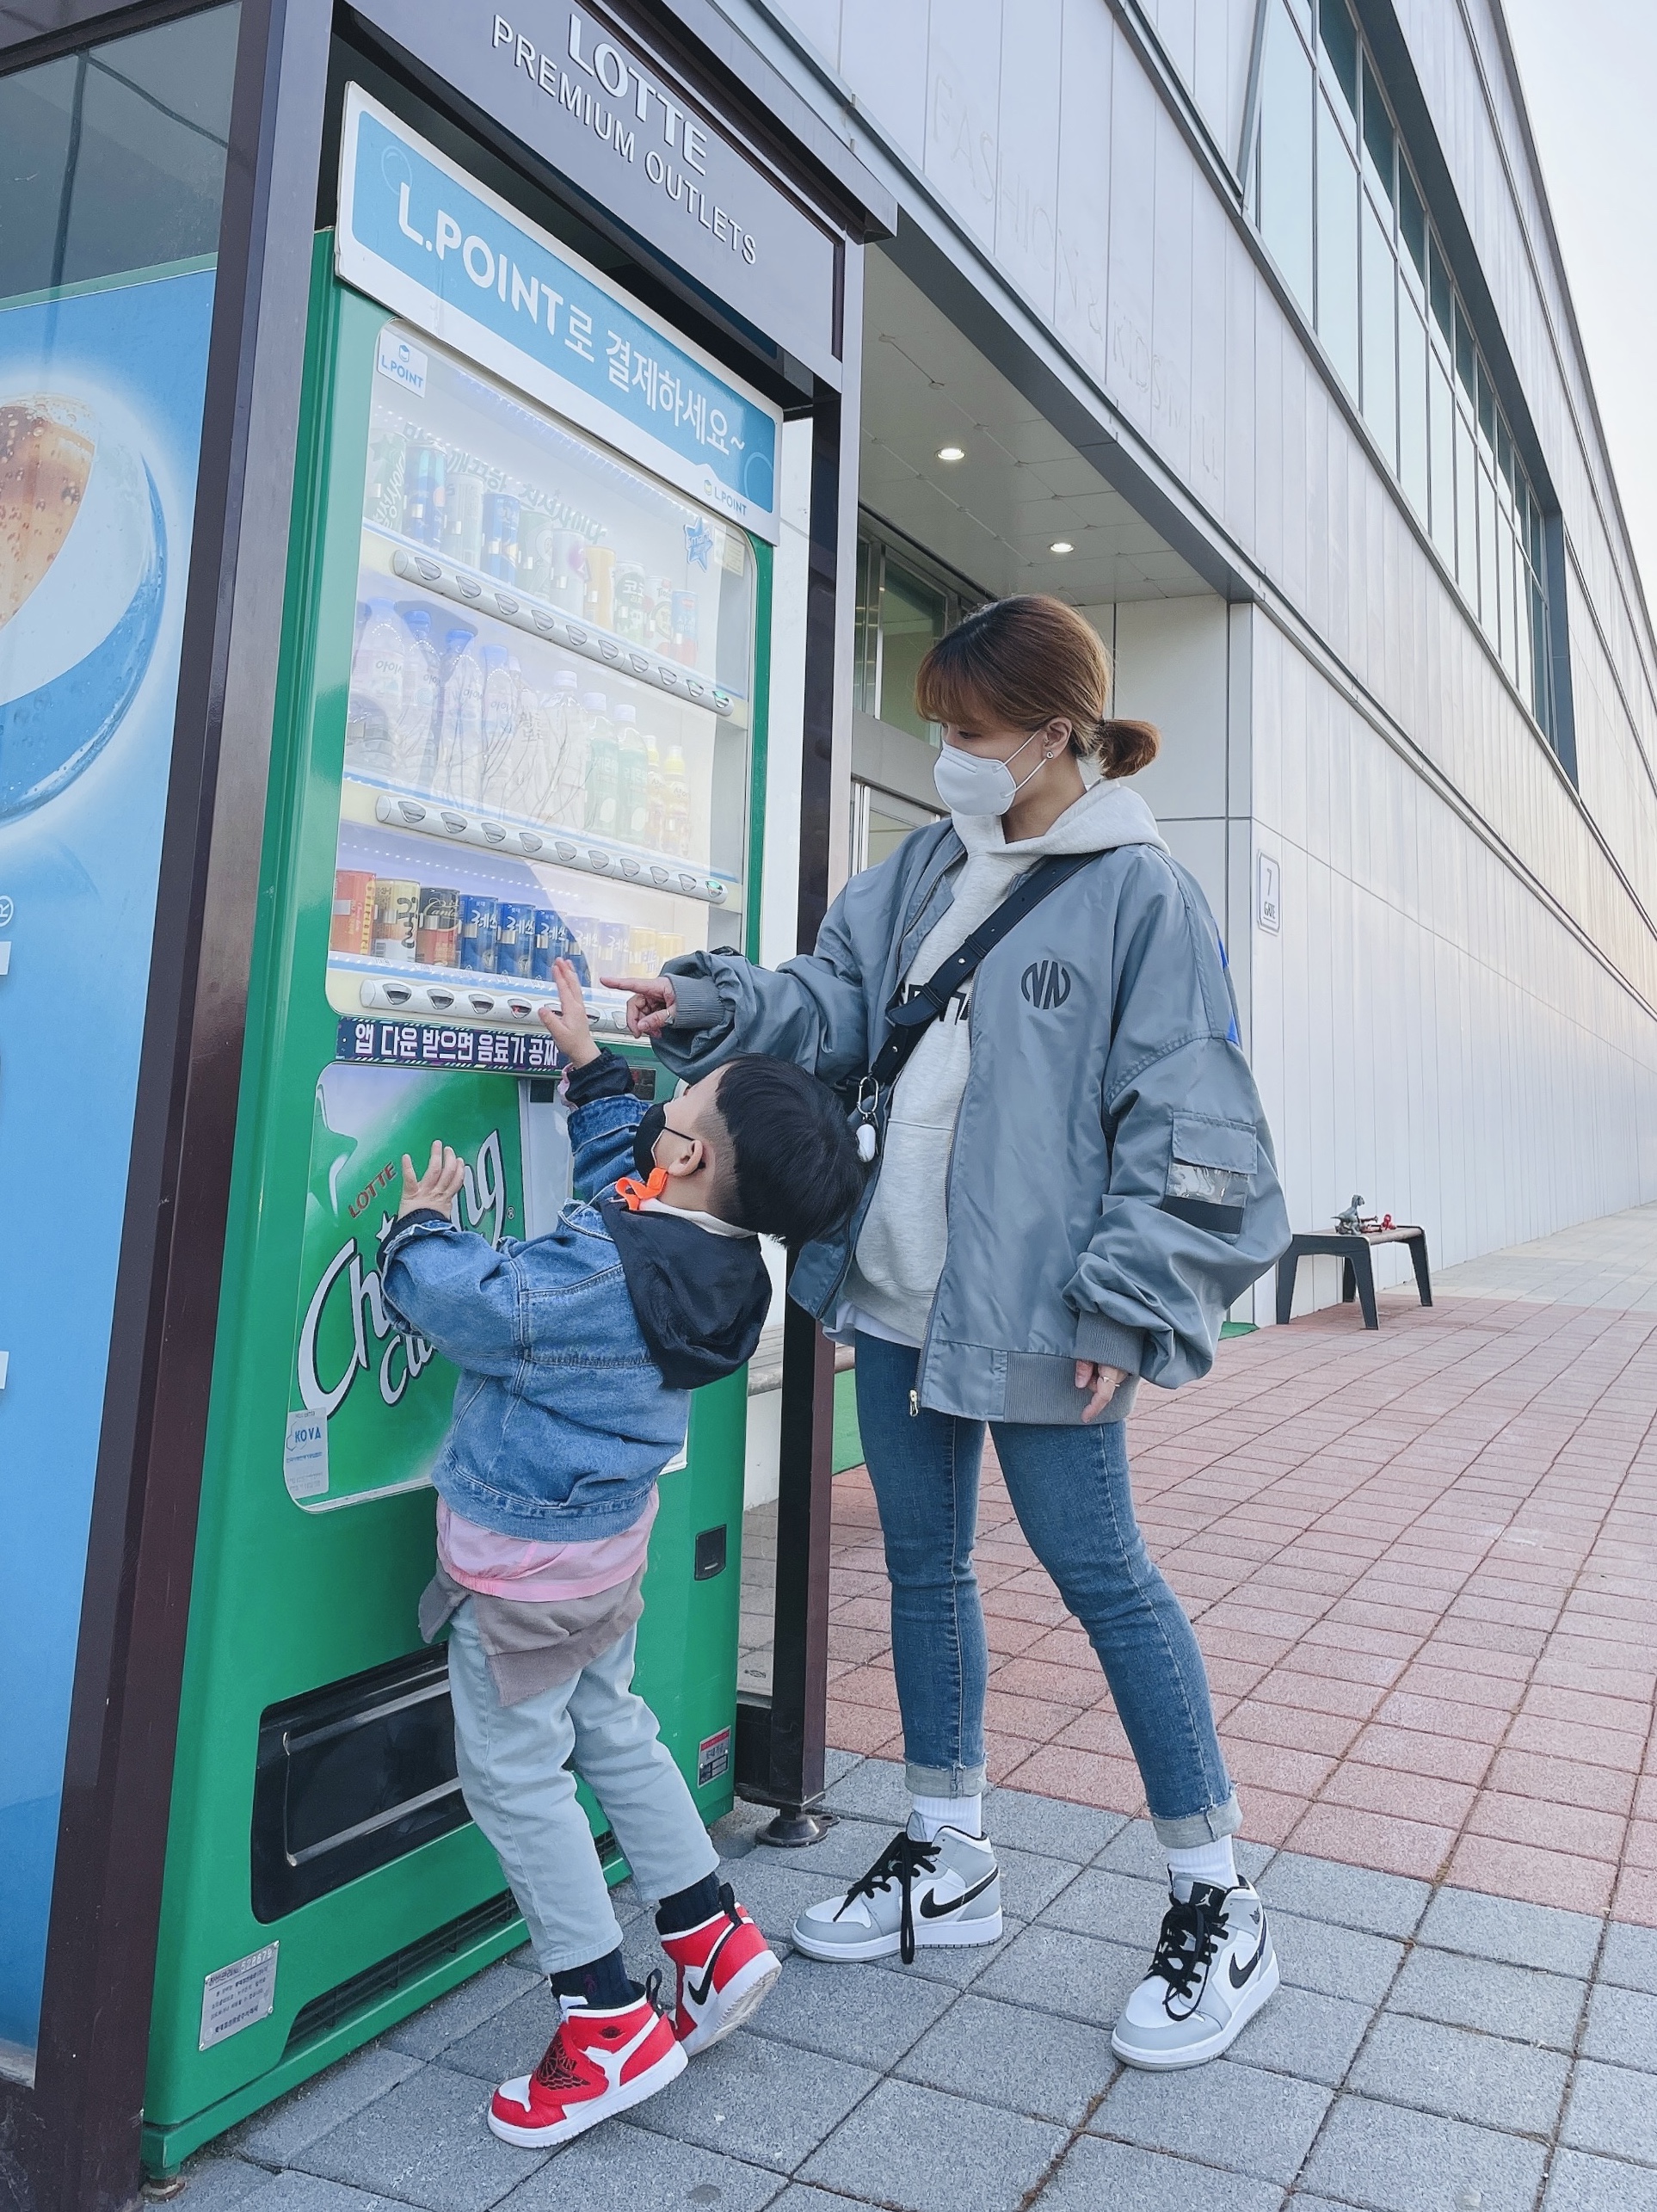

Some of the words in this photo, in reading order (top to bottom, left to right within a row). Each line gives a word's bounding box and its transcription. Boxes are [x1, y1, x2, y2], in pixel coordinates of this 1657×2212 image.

[567, 13, 708, 177] LOTTE
[491, 14, 635, 163] PREMIUM
[644, 150, 757, 265] OUTLETS
[380, 354, 424, 389] L.POINT
[1266, 867, 1272, 897] 7
[354, 1023, 374, 1056] 앱
[380, 1025, 418, 1057] 다운
[422, 1028, 473, 1062] 받으면
[477, 1033, 526, 1064] 음료가
[348, 1161, 397, 1219] LOTTE
[294, 1426, 322, 1444] KOVA
